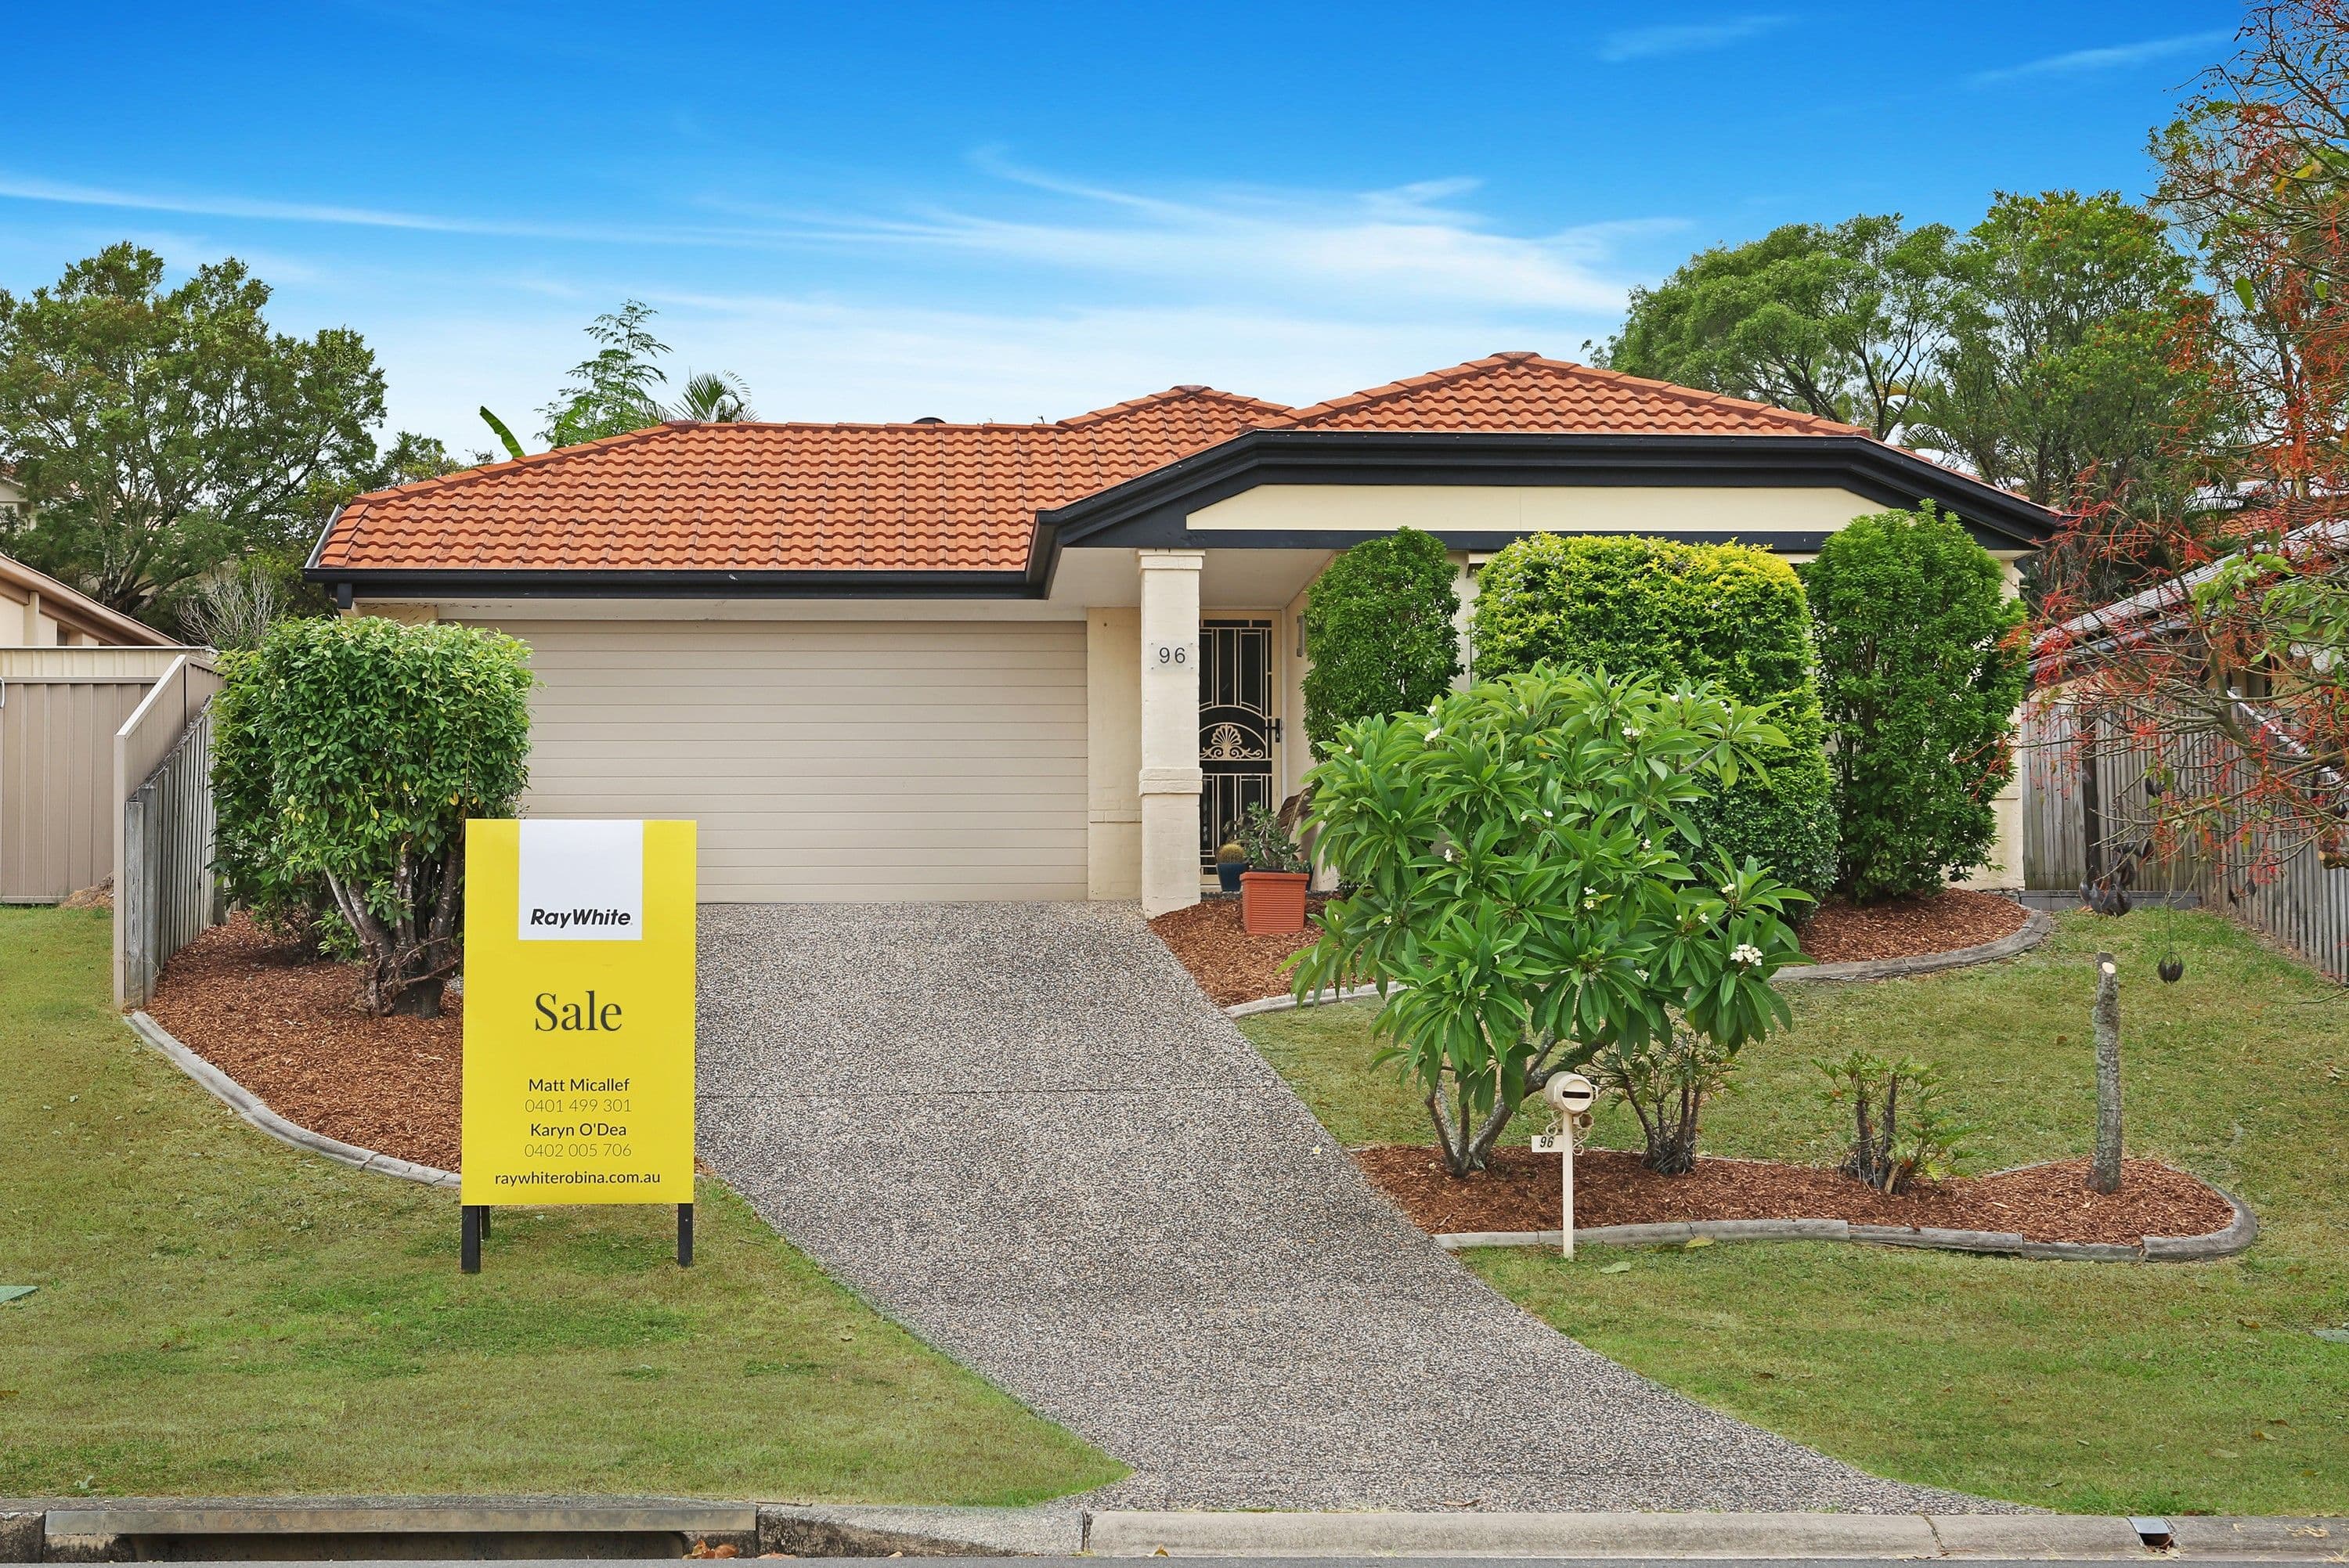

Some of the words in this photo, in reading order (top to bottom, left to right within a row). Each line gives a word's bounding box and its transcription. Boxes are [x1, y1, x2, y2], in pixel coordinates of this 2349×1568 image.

[1160, 647, 1185, 664] 96
[530, 908, 631, 928] RayWhite
[535, 990, 622, 1032] Sale
[529, 1078, 565, 1092] Matt
[570, 1077, 630, 1092] Micallef
[525, 1098, 564, 1112] 0401
[568, 1098, 598, 1112] 499
[603, 1098, 632, 1112] 301
[530, 1123, 575, 1139] Karyn
[579, 1123, 627, 1137] O'Dea
[1539, 1136, 1553, 1148] 96
[524, 1143, 564, 1158] 0402
[568, 1143, 598, 1157] 005
[603, 1143, 632, 1157] 706
[495, 1170, 661, 1187] raywhiterobina.com.au
